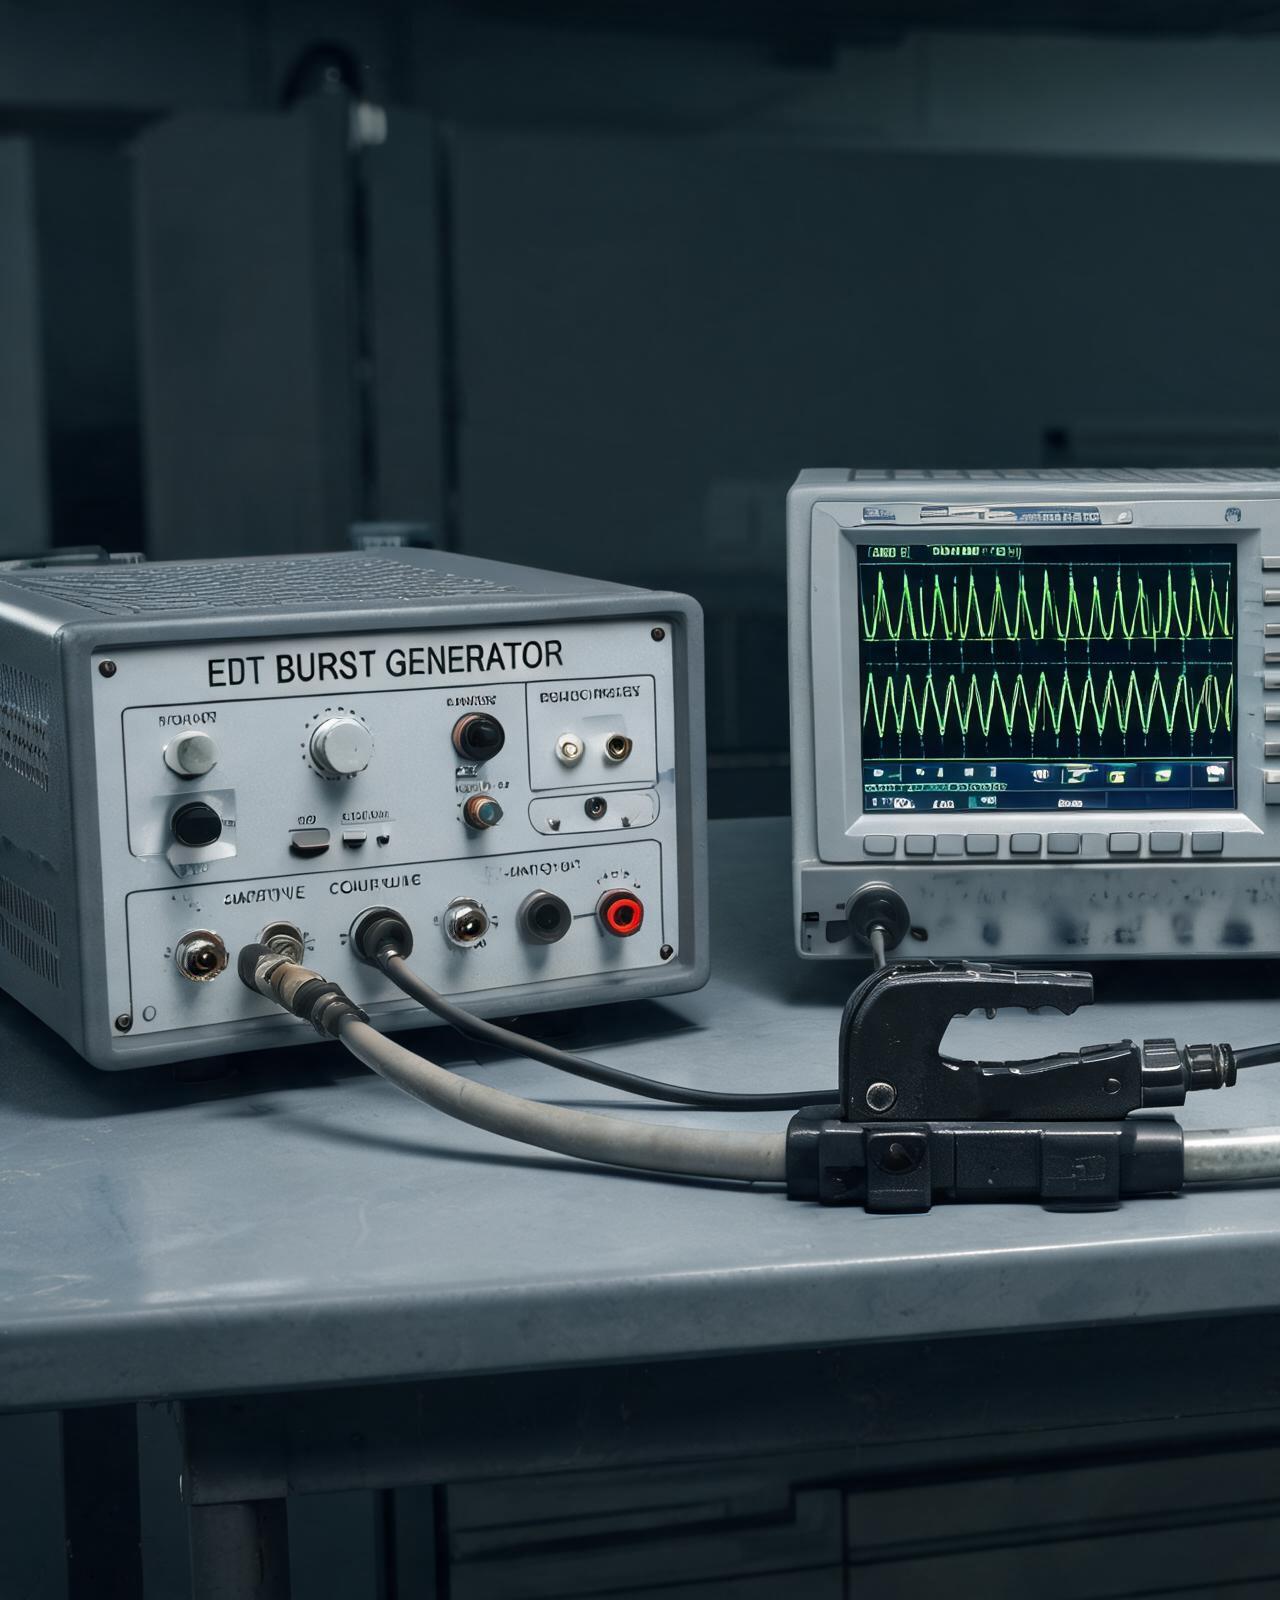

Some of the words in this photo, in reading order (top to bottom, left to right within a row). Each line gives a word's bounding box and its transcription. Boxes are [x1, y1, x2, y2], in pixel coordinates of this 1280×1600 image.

[208, 655, 265, 687] EDT
[276, 650, 376, 684] BURST
[386, 639, 564, 677] GENERATOR
